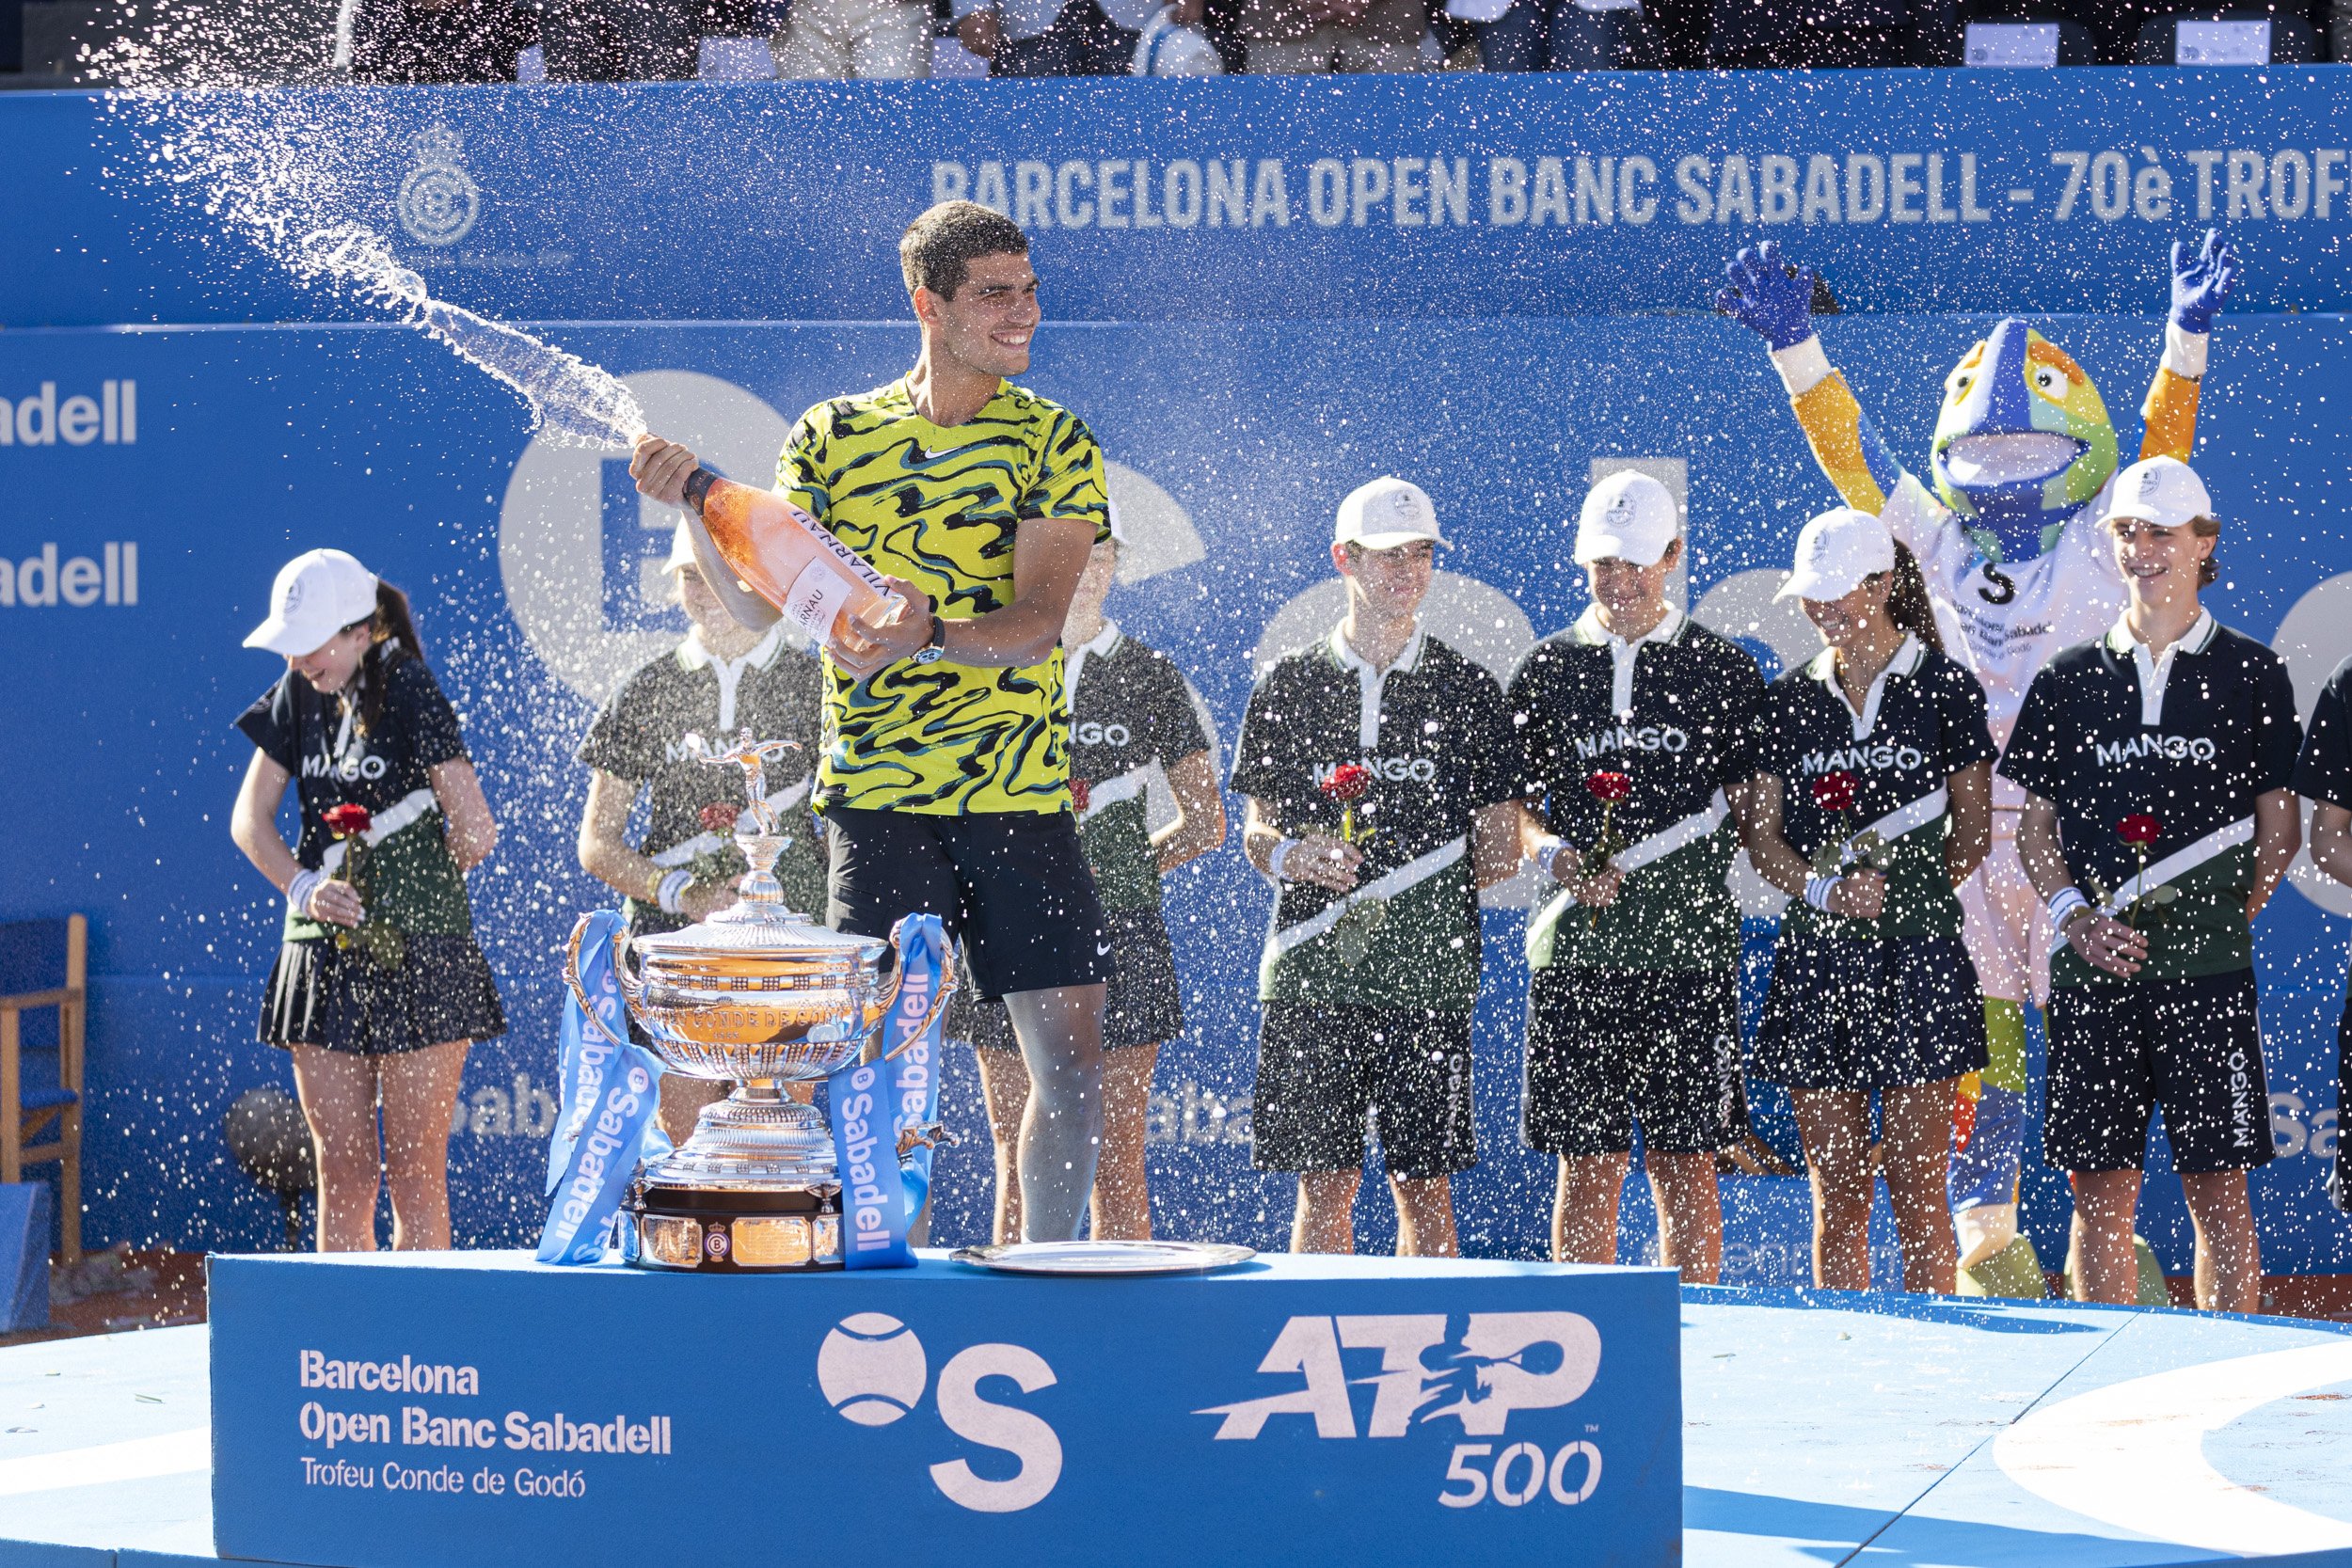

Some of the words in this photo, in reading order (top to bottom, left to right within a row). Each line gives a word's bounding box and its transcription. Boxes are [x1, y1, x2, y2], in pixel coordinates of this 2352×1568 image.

[932, 158, 1290, 229] BARCELONA
[1311, 157, 1470, 227] OPEN
[1489, 155, 1657, 226] BANC
[1675, 152, 1991, 225] SABADELL
[2051, 146, 2171, 221] 70è
[2186, 148, 2352, 219] TROF
[792, 511, 891, 597] VILARNAU
[1312, 756, 1436, 786] MNGO
[1574, 725, 1688, 760] MANGO
[1802, 746, 1922, 776] MANGO
[2096, 734, 2216, 767] MANGO
[2229, 1052, 2249, 1148] MANGO
[555, 1086, 640, 1241] Sabadell
[841, 1093, 890, 1251] Sabadell
[300, 1350, 479, 1395] Barcelona
[1191, 1310, 1601, 1439] ATP
[299, 1402, 390, 1449] Open
[402, 1406, 497, 1449] Banc
[503, 1411, 671, 1454] Sabadell
[300, 1457, 374, 1488] Trofeu
[382, 1461, 464, 1493] Conde
[472, 1465, 505, 1495] de
[515, 1467, 586, 1498] Godó
[1438, 1440, 1602, 1509] 500
